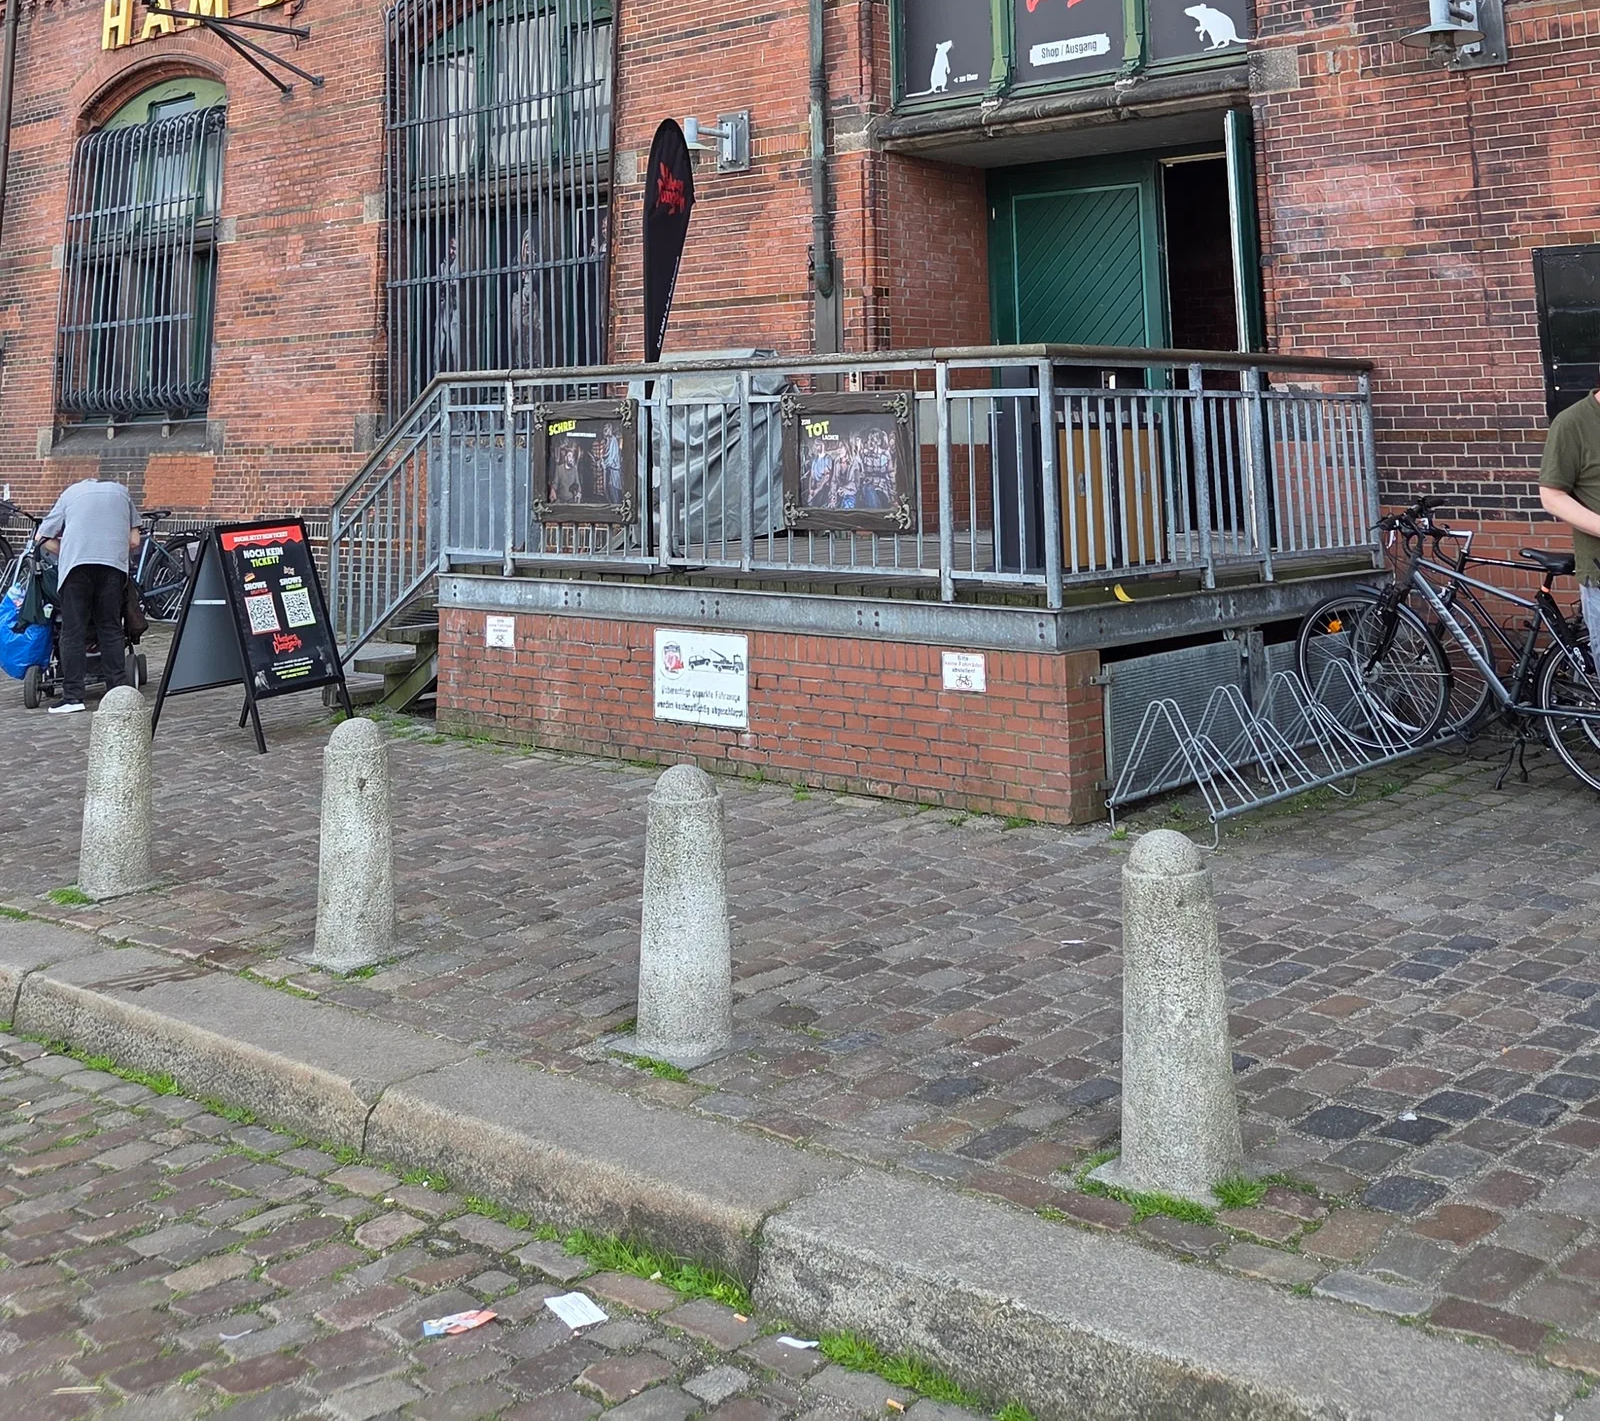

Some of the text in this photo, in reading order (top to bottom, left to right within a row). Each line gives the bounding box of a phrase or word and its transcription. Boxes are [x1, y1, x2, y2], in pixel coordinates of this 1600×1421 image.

[1041, 44, 1059, 59] Shop
[1065, 40, 1098, 57] Ausgang
[805, 421, 829, 438] TOT
[243, 546, 284, 559] NOCH KEIN
[250, 556, 280, 568] TICKET?
